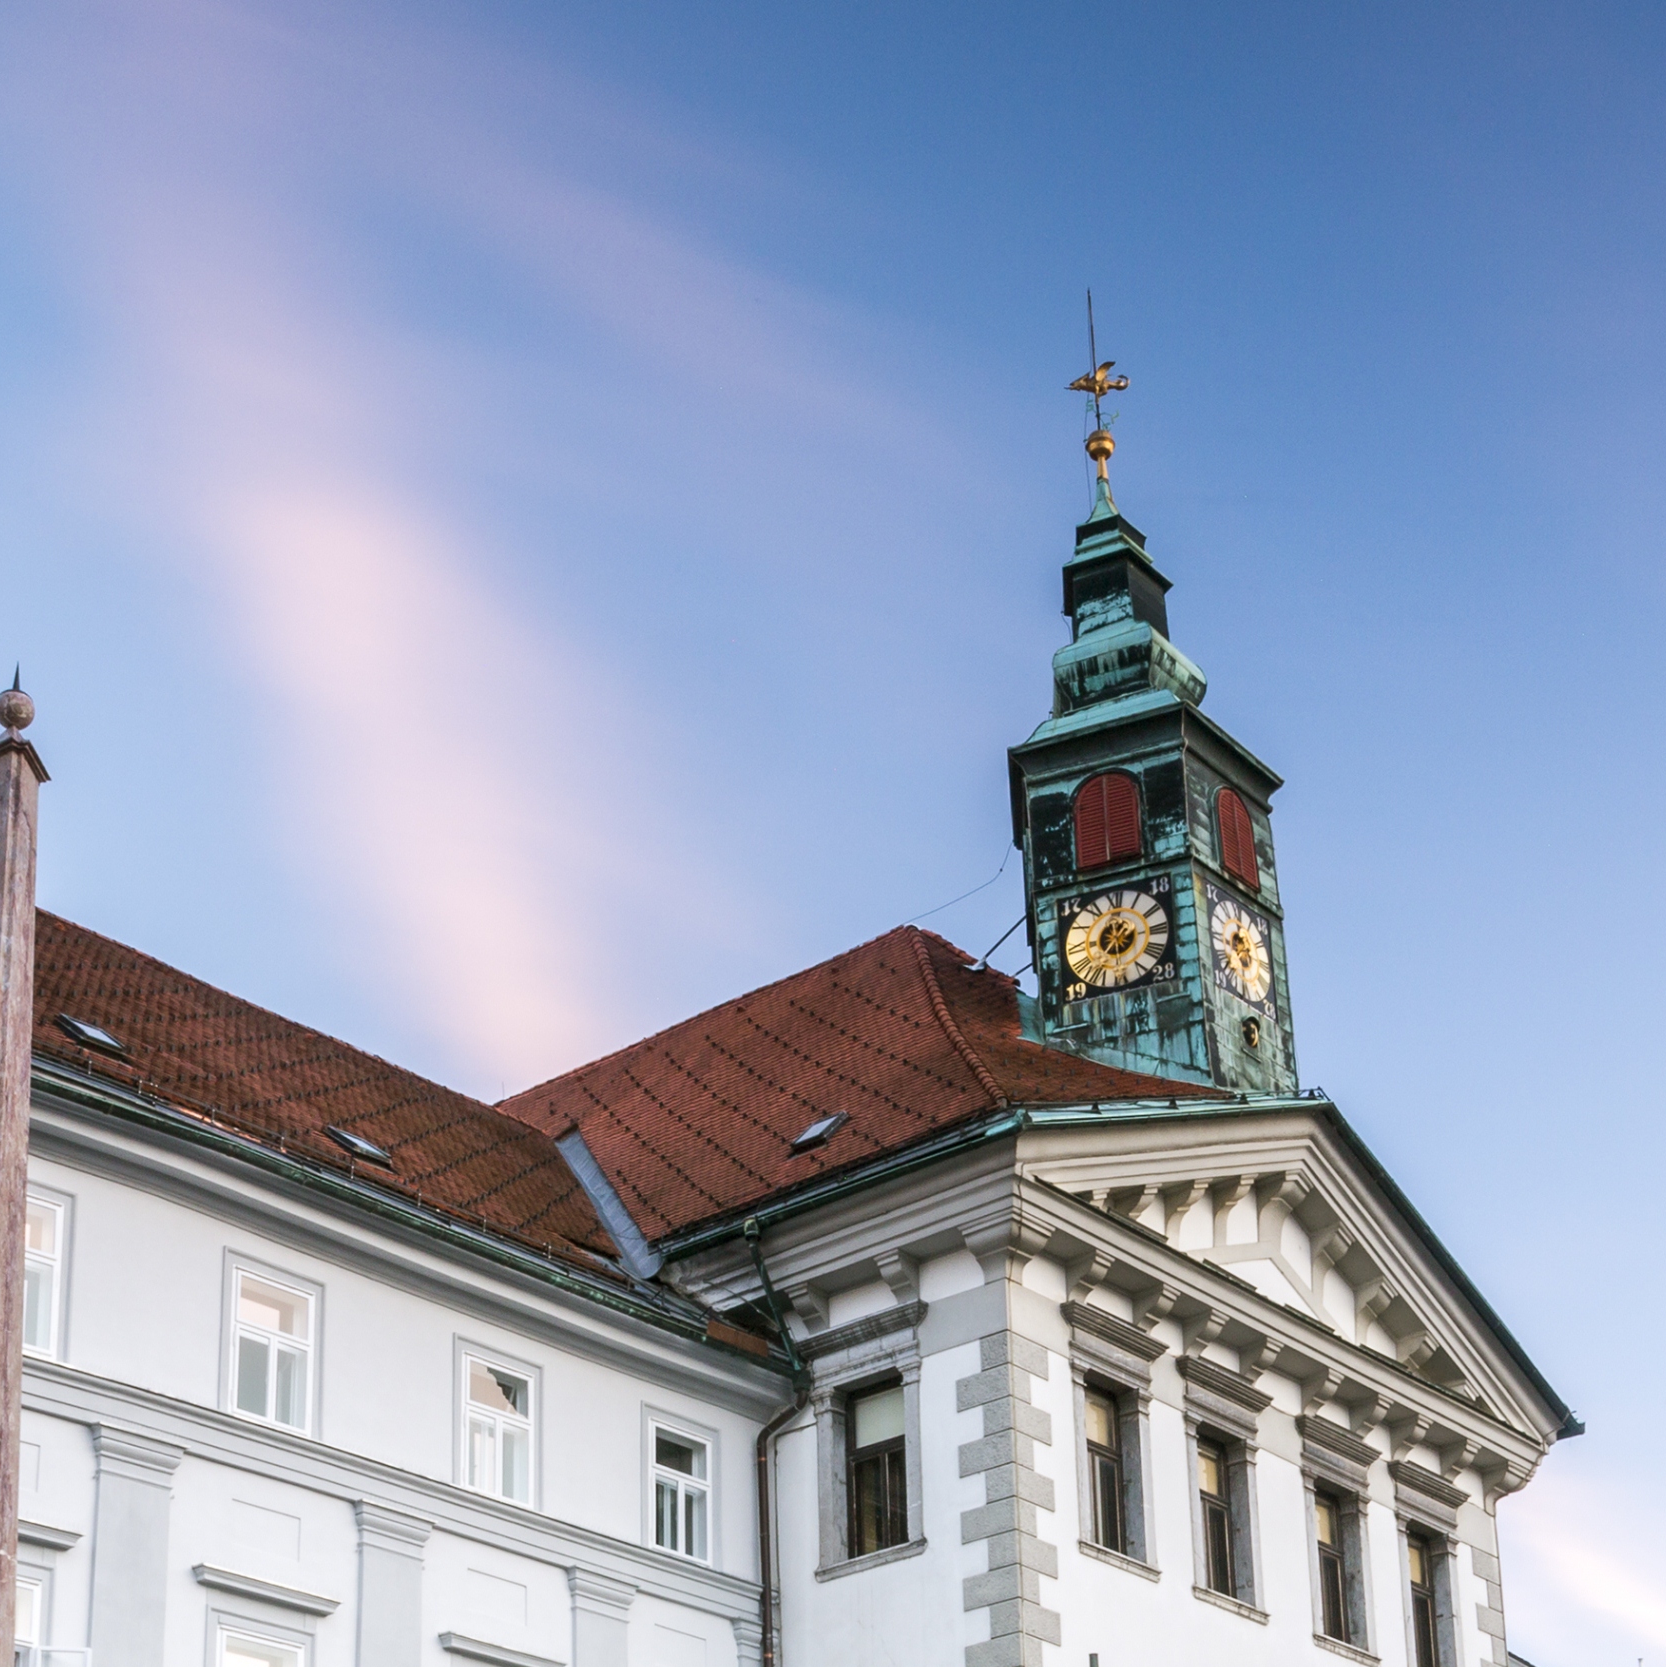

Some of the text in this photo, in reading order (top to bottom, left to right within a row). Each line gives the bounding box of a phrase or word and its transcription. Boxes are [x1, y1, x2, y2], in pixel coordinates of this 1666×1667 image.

[1149, 877, 1169, 895] 18
[1061, 898, 1081, 916] 17
[1152, 962, 1175, 981] 28
[1065, 982, 1087, 1001] 19
